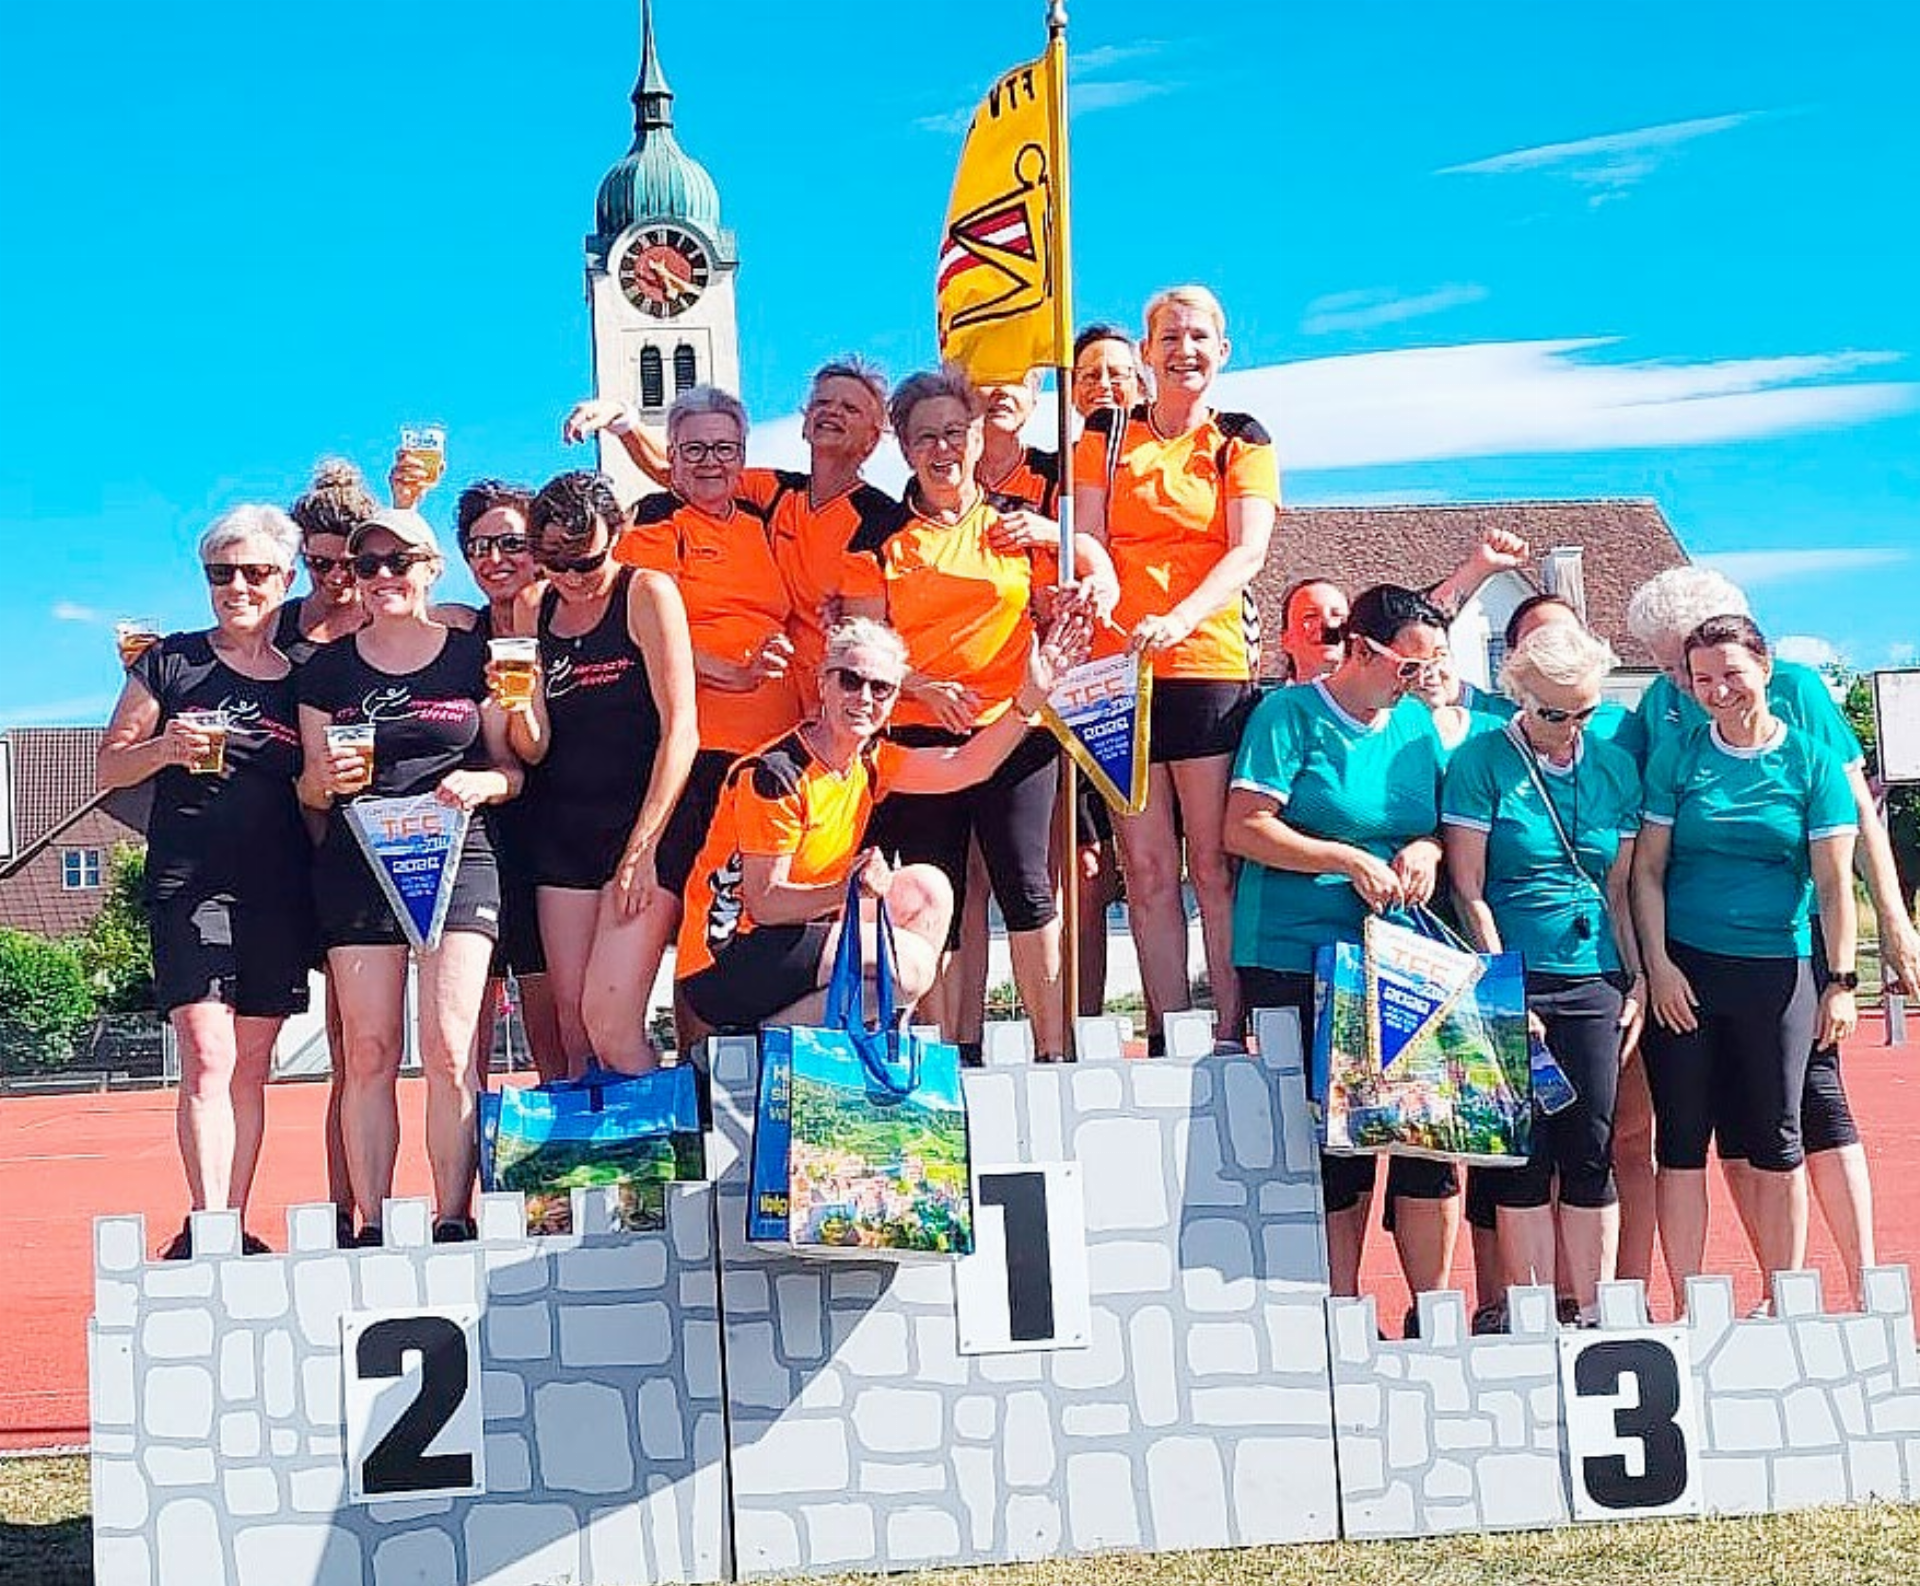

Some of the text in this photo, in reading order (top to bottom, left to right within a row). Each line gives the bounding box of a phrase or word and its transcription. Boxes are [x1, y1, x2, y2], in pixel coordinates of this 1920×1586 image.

[980, 1173, 1054, 1340] 1
[357, 1317, 472, 1493] 2
[1575, 1340, 1686, 1509] 3
